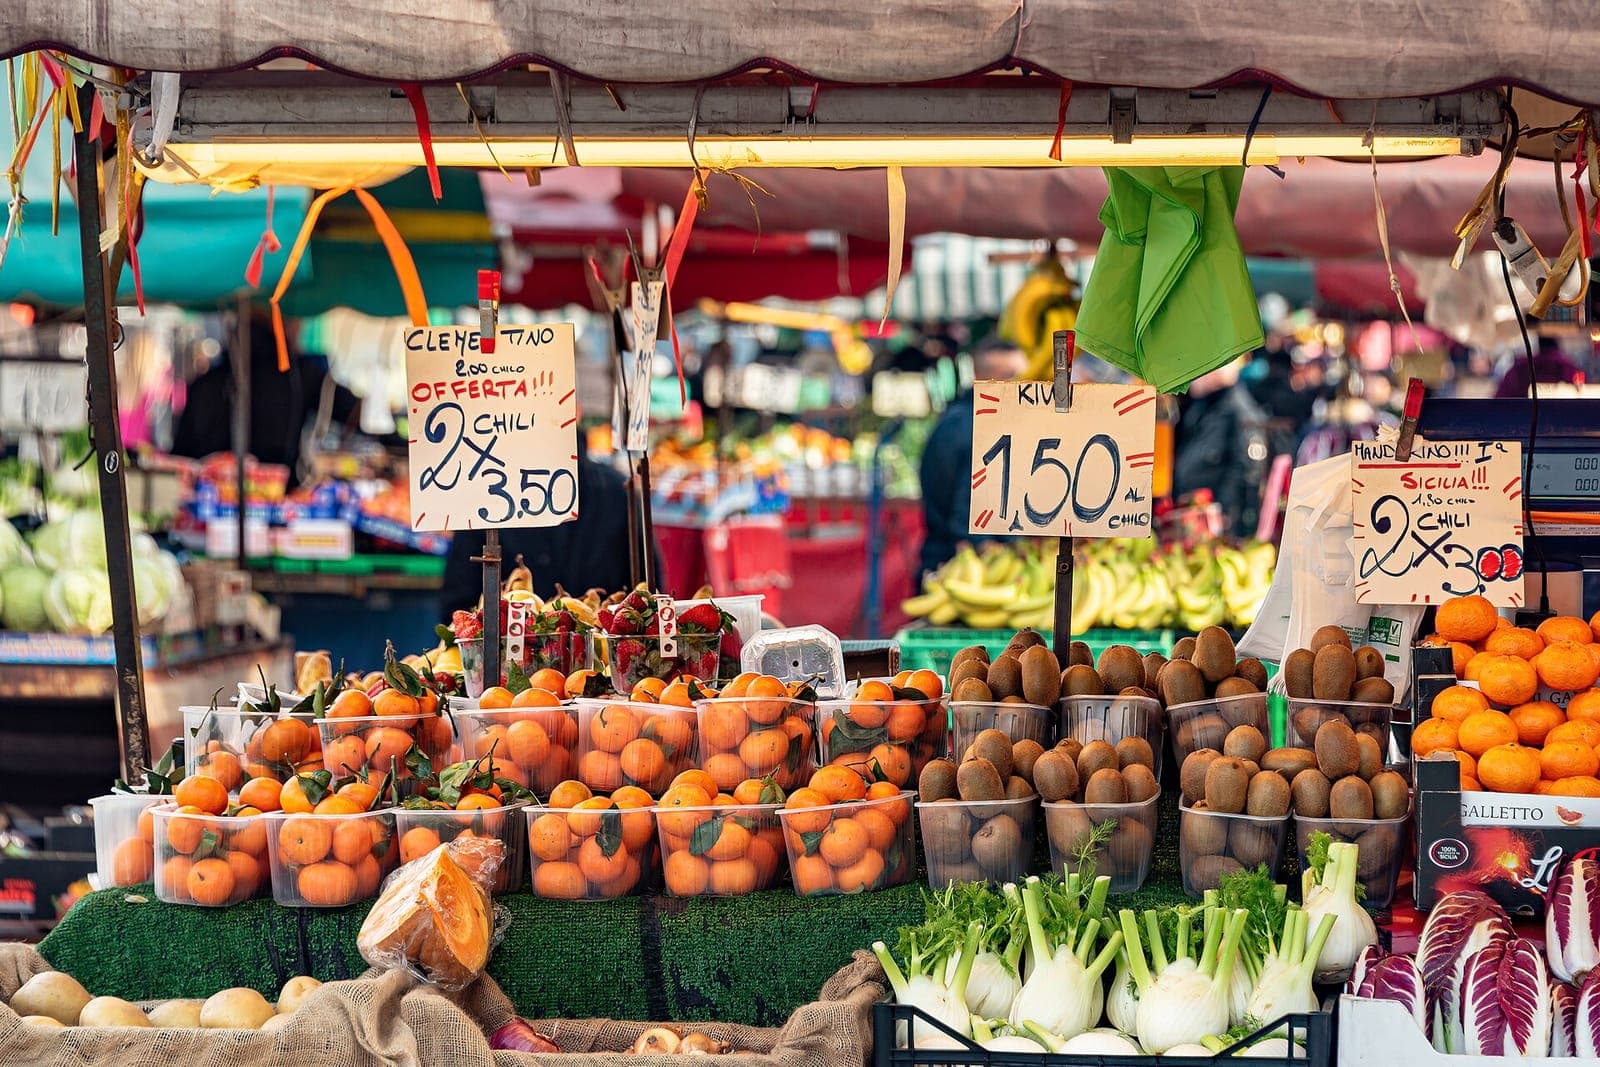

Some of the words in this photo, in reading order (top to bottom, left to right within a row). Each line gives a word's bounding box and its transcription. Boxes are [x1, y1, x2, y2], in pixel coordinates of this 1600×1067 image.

[406, 327, 554, 355] CLEMETINO
[492, 365, 525, 375] CHILO
[411, 370, 554, 402] OFFERTA!!!
[473, 413, 535, 435] CHILI
[1400, 466, 1490, 490] SICILIA!!!
[1124, 487, 1145, 502] AL
[1108, 512, 1151, 529] CHILO
[1417, 513, 1470, 530] CHILI
